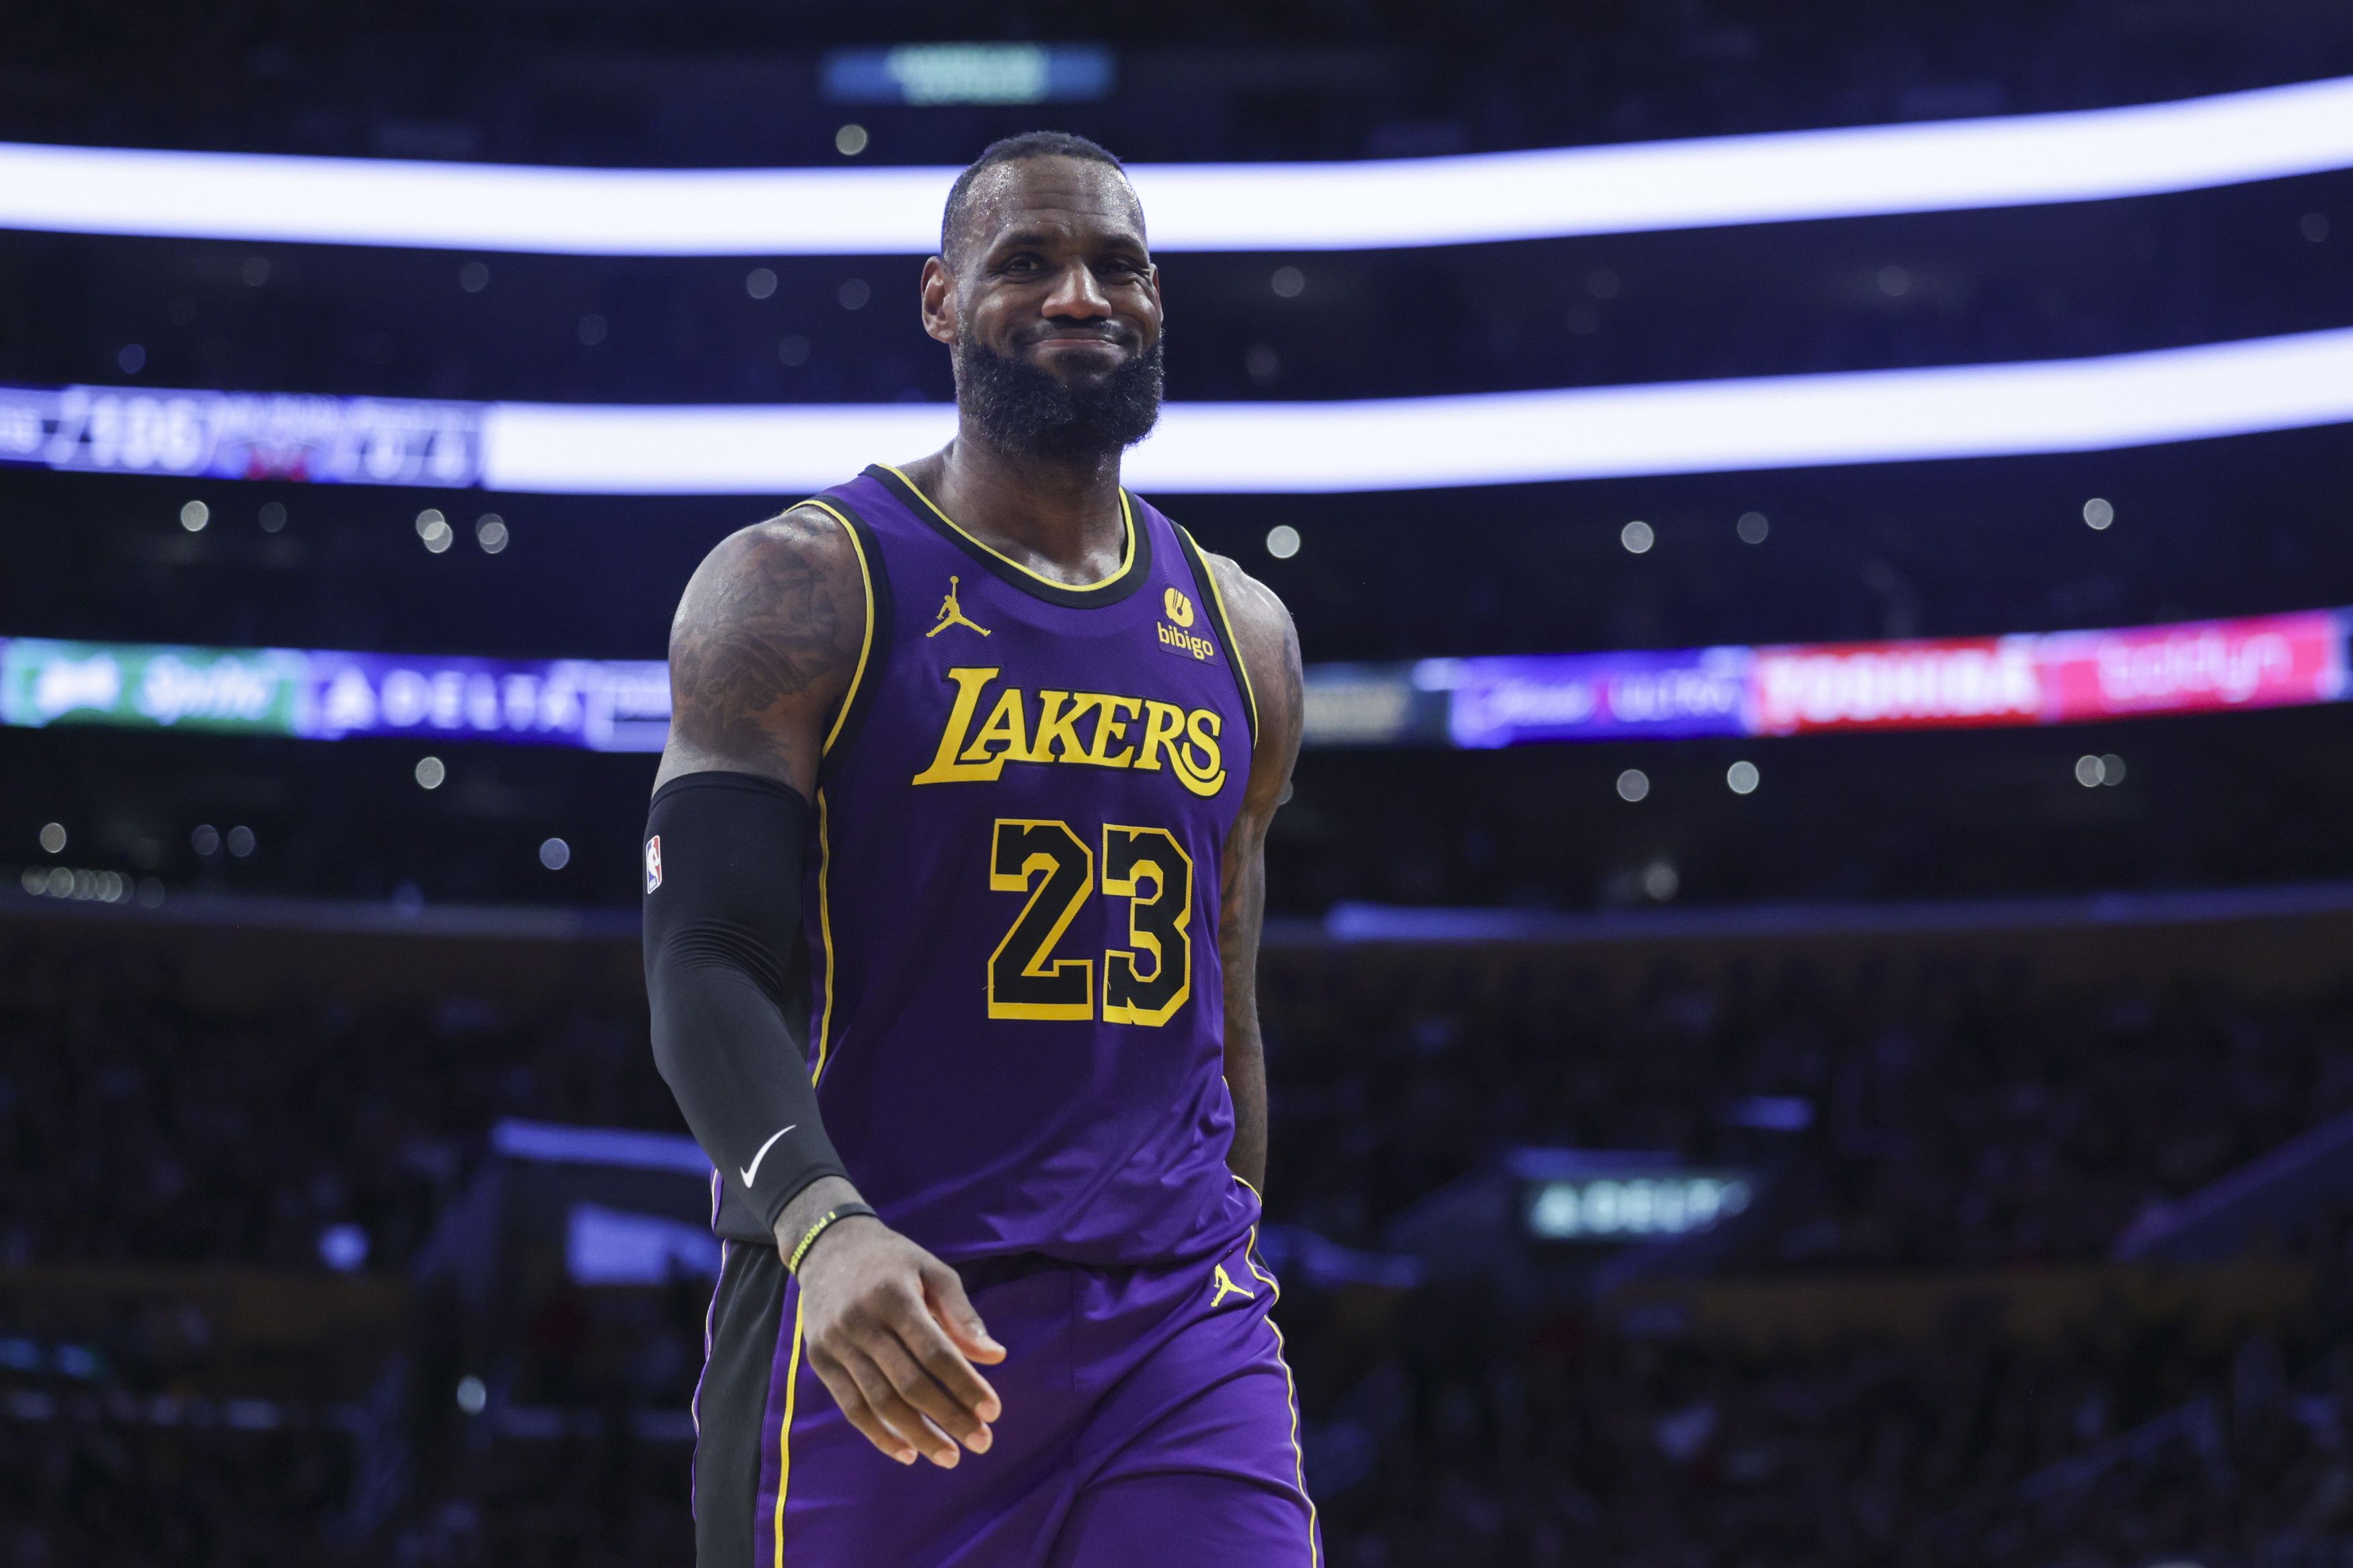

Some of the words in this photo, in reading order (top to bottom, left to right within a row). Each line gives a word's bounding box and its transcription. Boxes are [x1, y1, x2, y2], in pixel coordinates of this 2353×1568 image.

[1157, 621, 1214, 660] bibigo
[912, 667, 1226, 797] LAKERS
[988, 818, 1193, 1028] 23
